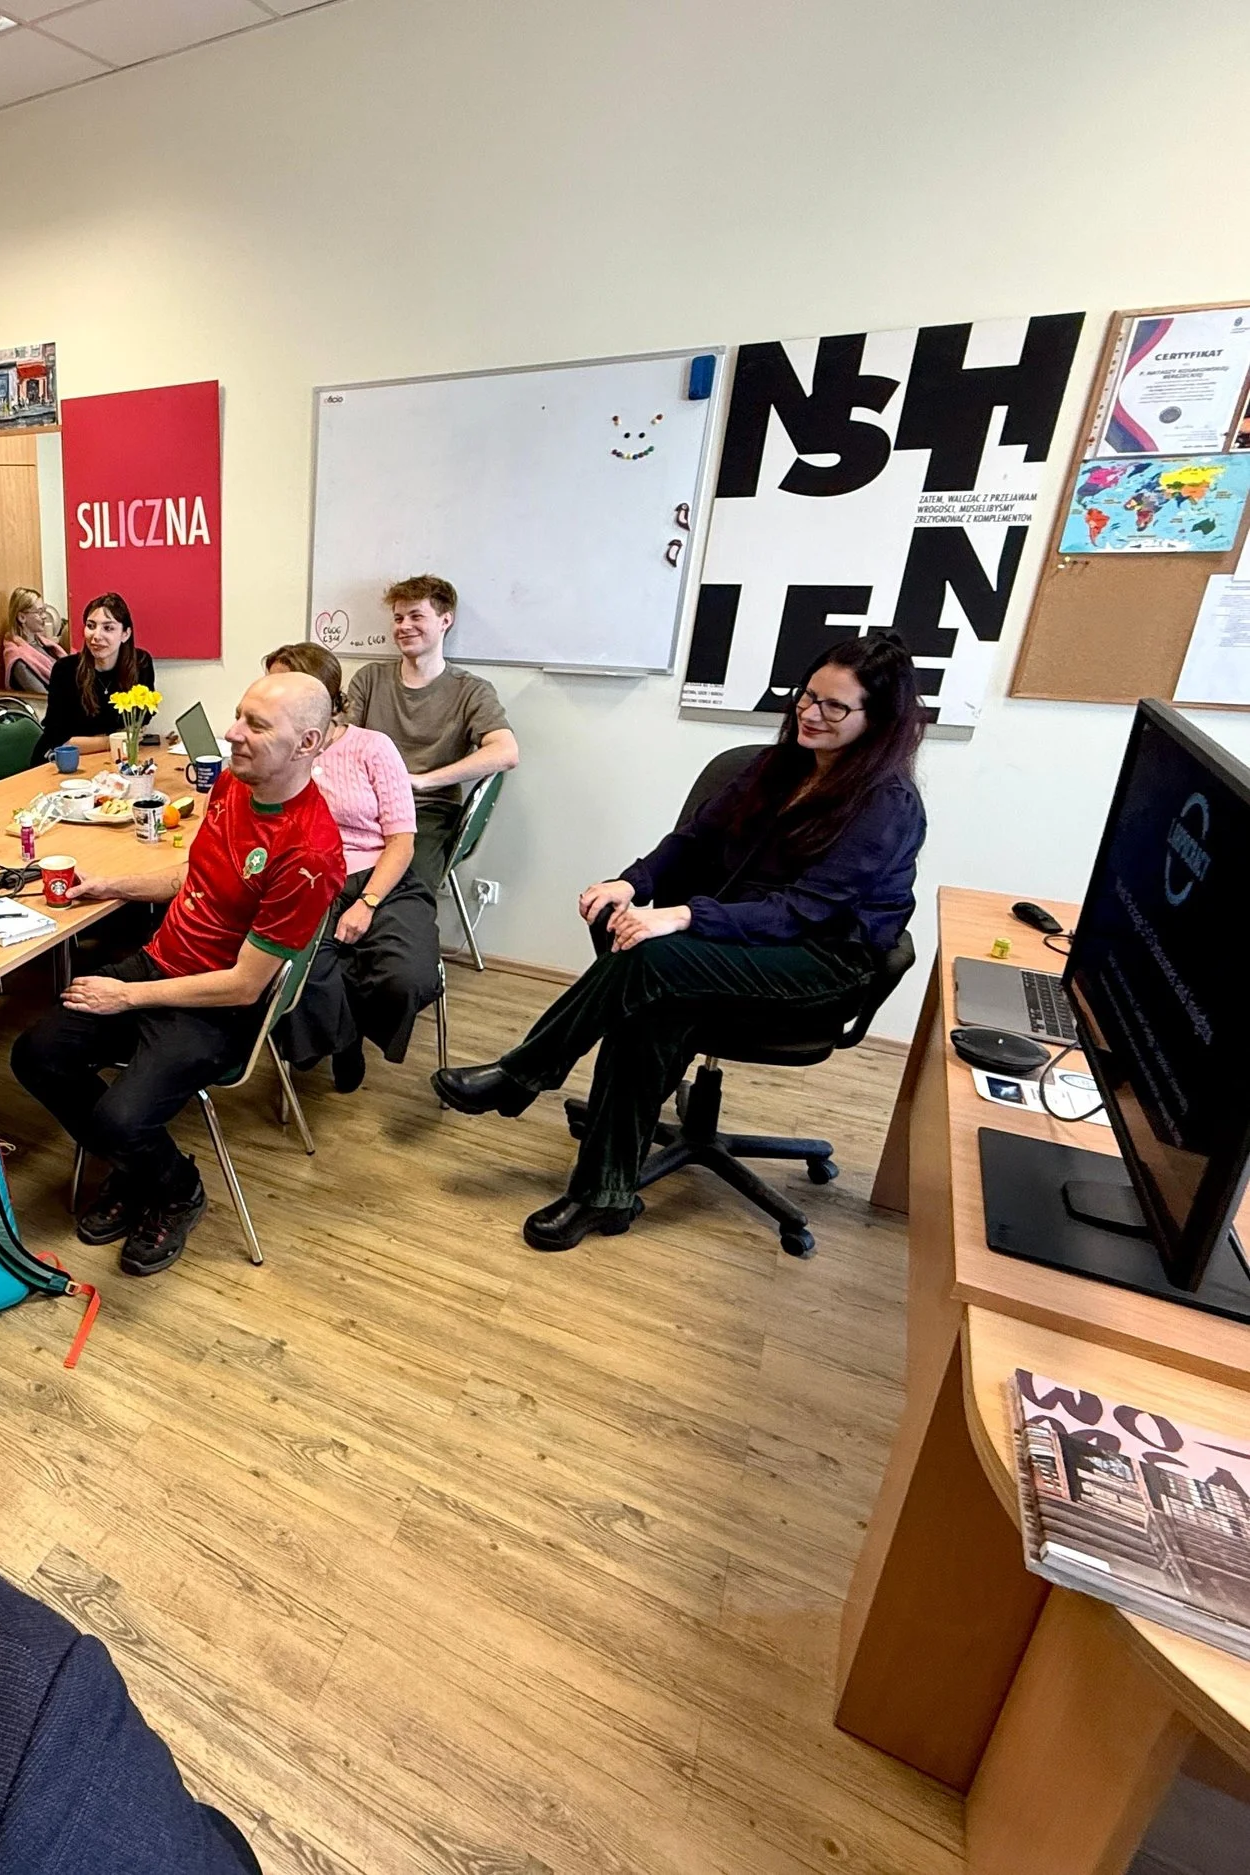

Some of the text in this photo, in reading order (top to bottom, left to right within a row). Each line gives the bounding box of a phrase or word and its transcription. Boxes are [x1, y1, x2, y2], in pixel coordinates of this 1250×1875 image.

[1155, 349, 1224, 361] CERTYFIKAT
[918, 495, 945, 504] ZATEM,
[948, 494, 981, 503] WALCZĄC
[982, 494, 990, 502] Z
[959, 503, 1015, 513] MUSIELIBYŚMY
[77, 496, 211, 549] SILICZNA
[914, 514, 965, 524] ZREZYGNOWAĆ
[966, 514, 974, 523] Z
